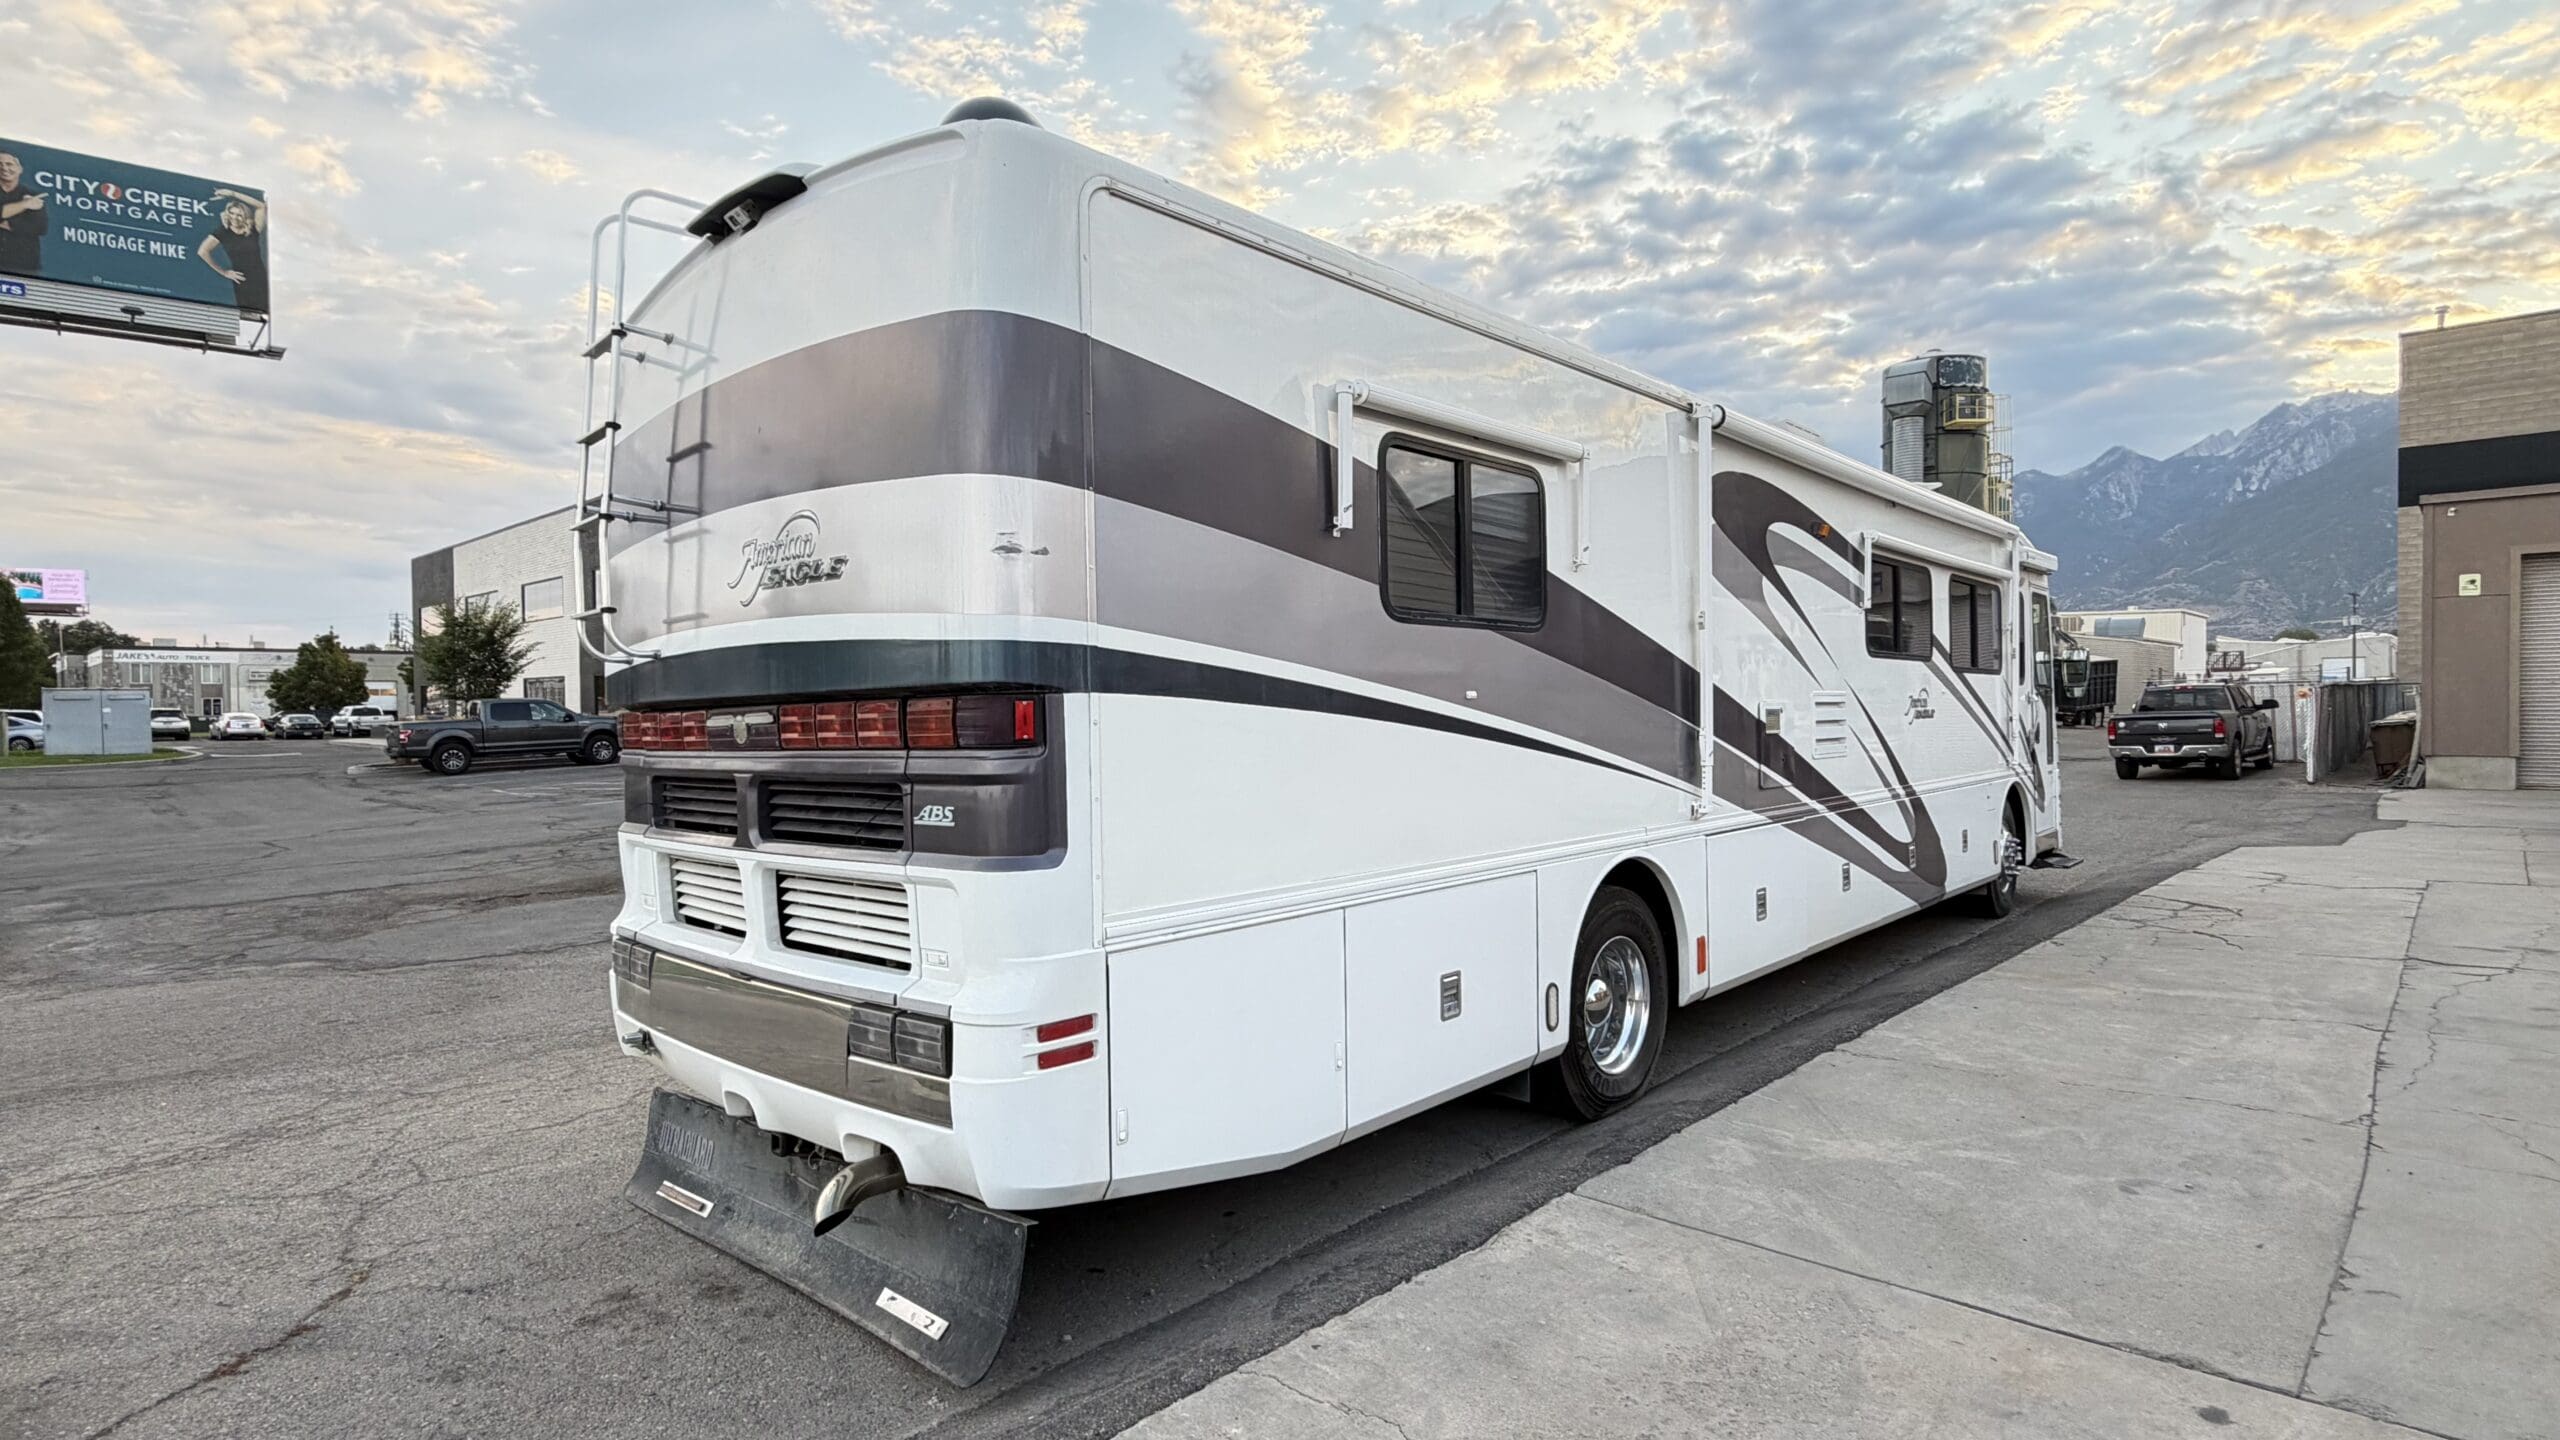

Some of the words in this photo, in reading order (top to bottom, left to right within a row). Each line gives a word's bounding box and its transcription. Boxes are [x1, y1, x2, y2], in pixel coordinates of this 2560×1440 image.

[34, 171, 100, 195] CITY
[125, 188, 210, 216] CREEK
[55, 193, 193, 228] MORTGAGE
[63, 226, 146, 254] MORTGAGE
[149, 241, 187, 260] MIKE
[0, 283, 23, 295] rs
[728, 530, 817, 589] American
[761, 555, 849, 590] EAGLE
[913, 804, 955, 822] ABS
